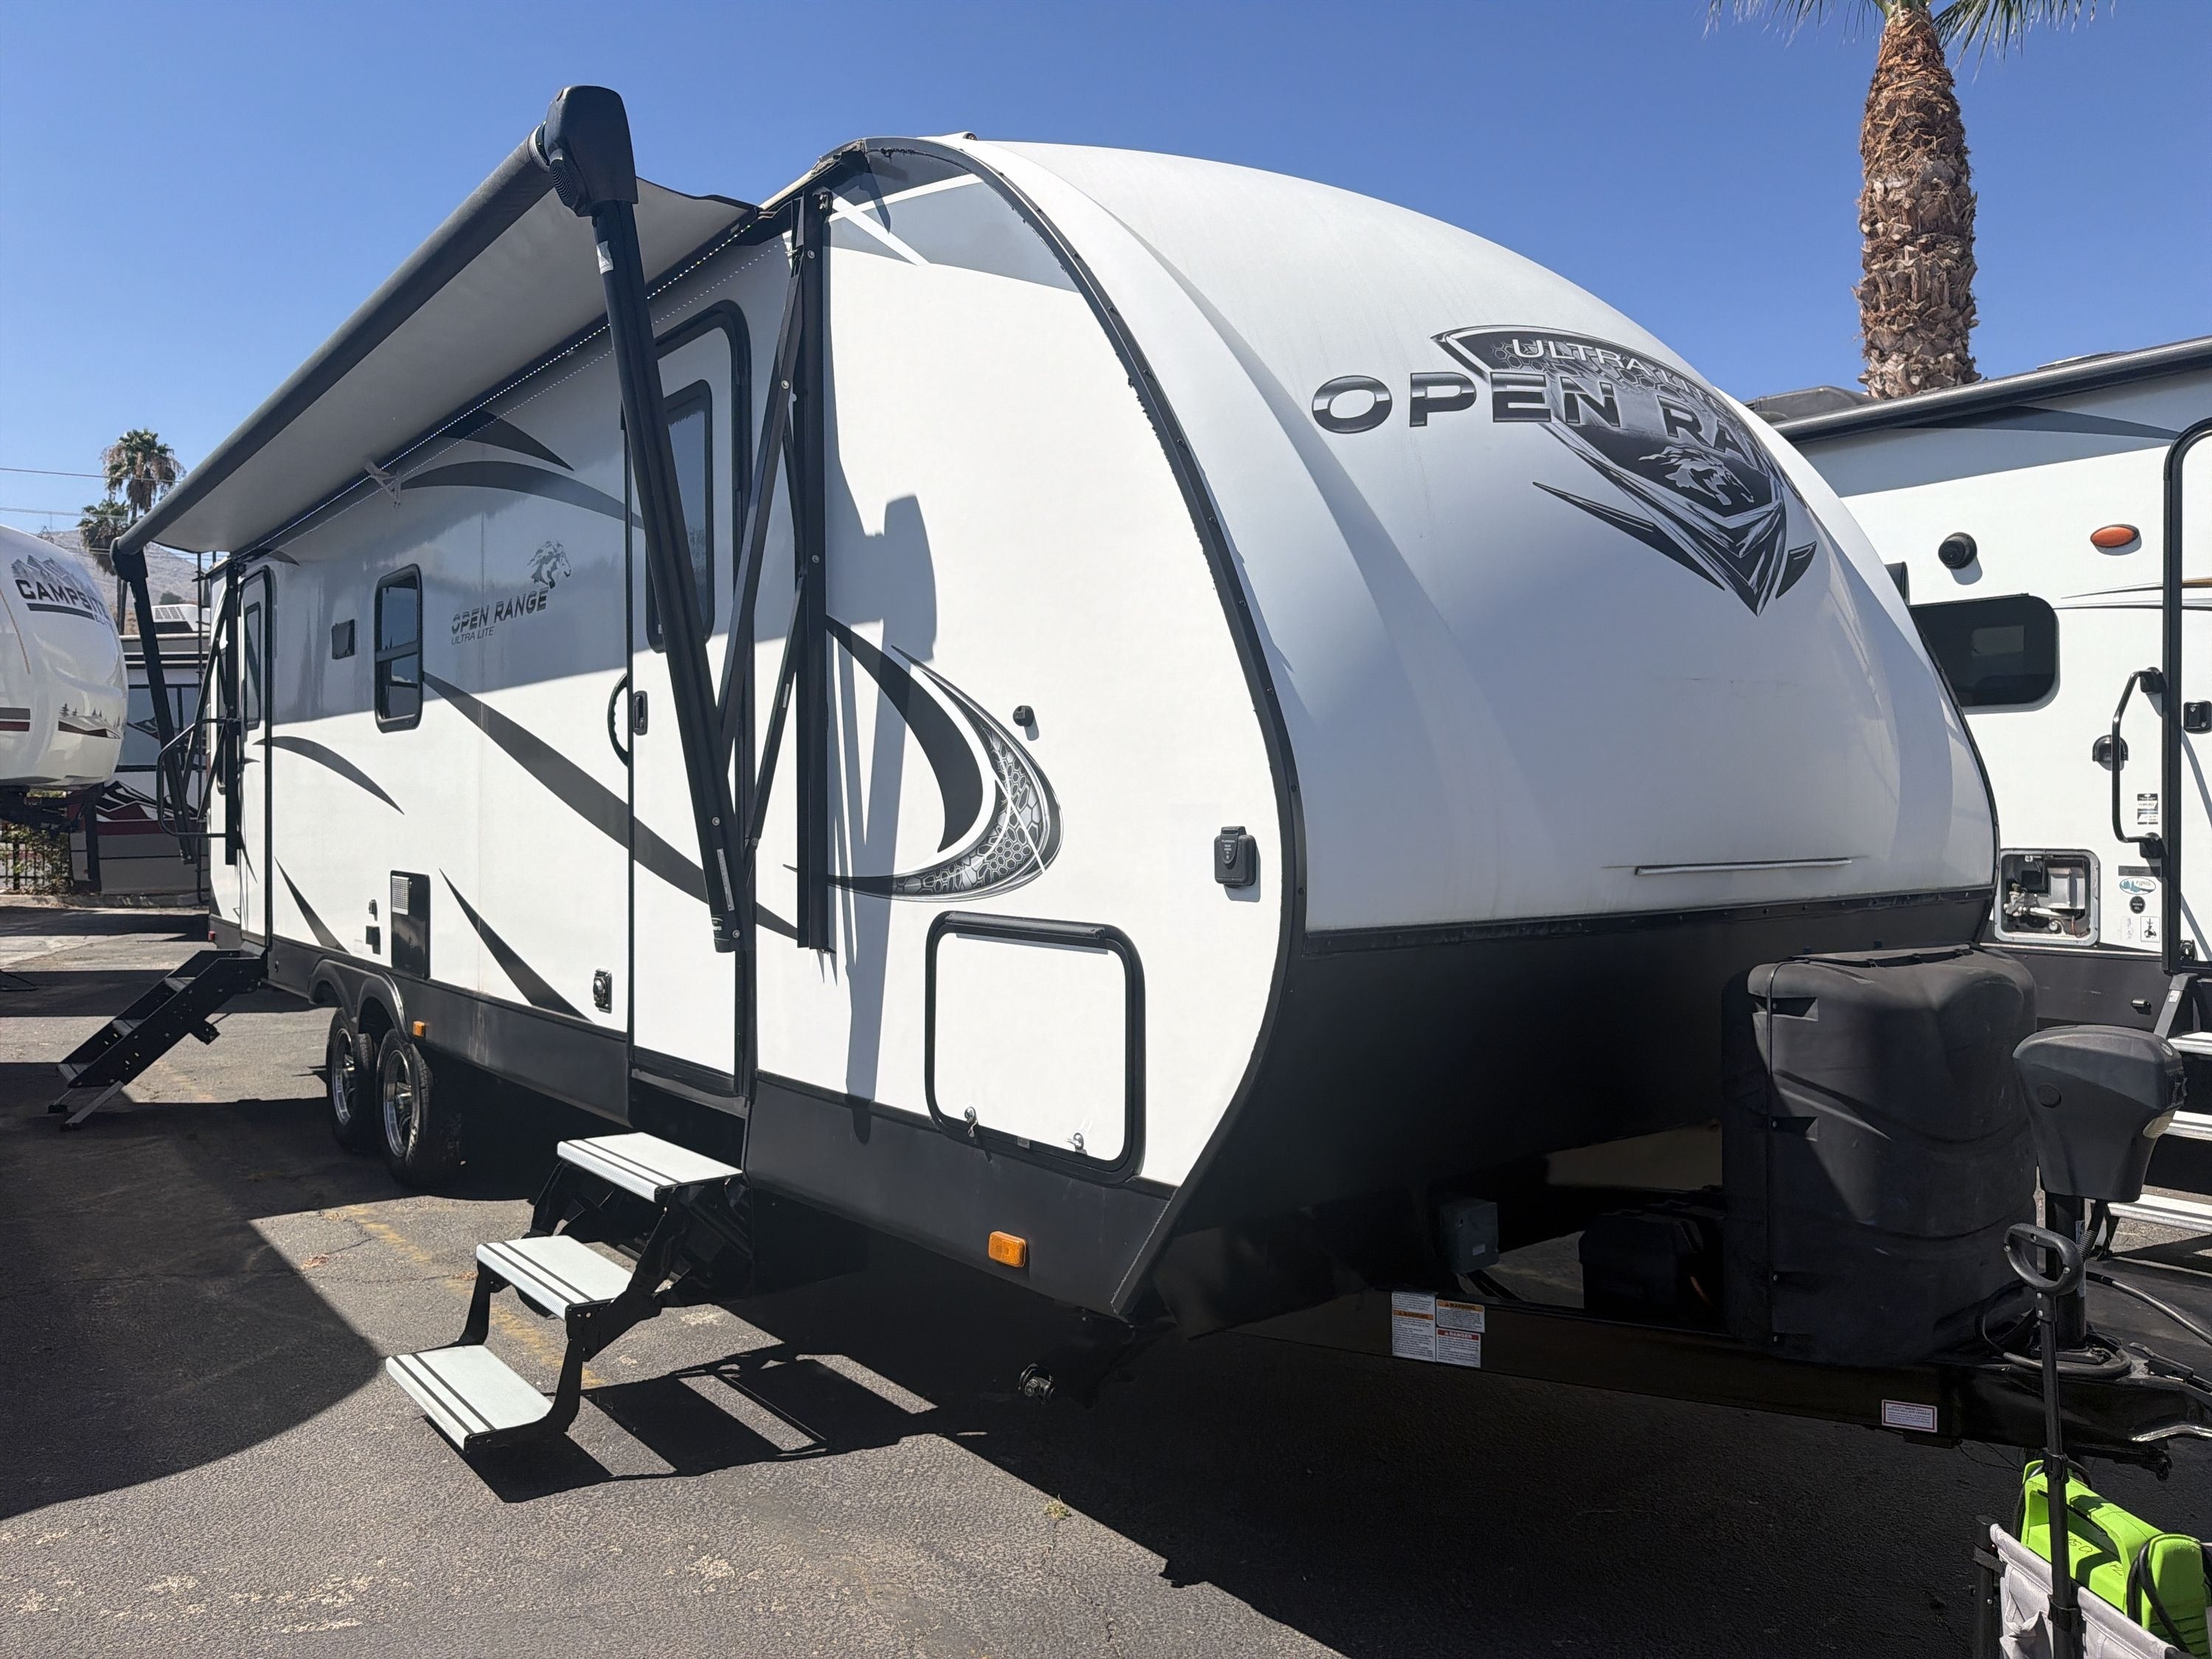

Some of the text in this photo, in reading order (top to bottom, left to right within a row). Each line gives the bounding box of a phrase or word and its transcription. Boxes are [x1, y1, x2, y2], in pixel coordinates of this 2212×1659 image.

[1512, 337, 1654, 378] ULTRA
[1311, 371, 1622, 434] OPEN
[451, 588, 549, 635] OPEN RANGE
[451, 626, 495, 645] ULTRA LITE
[1448, 1331, 1472, 1340] DANGER
